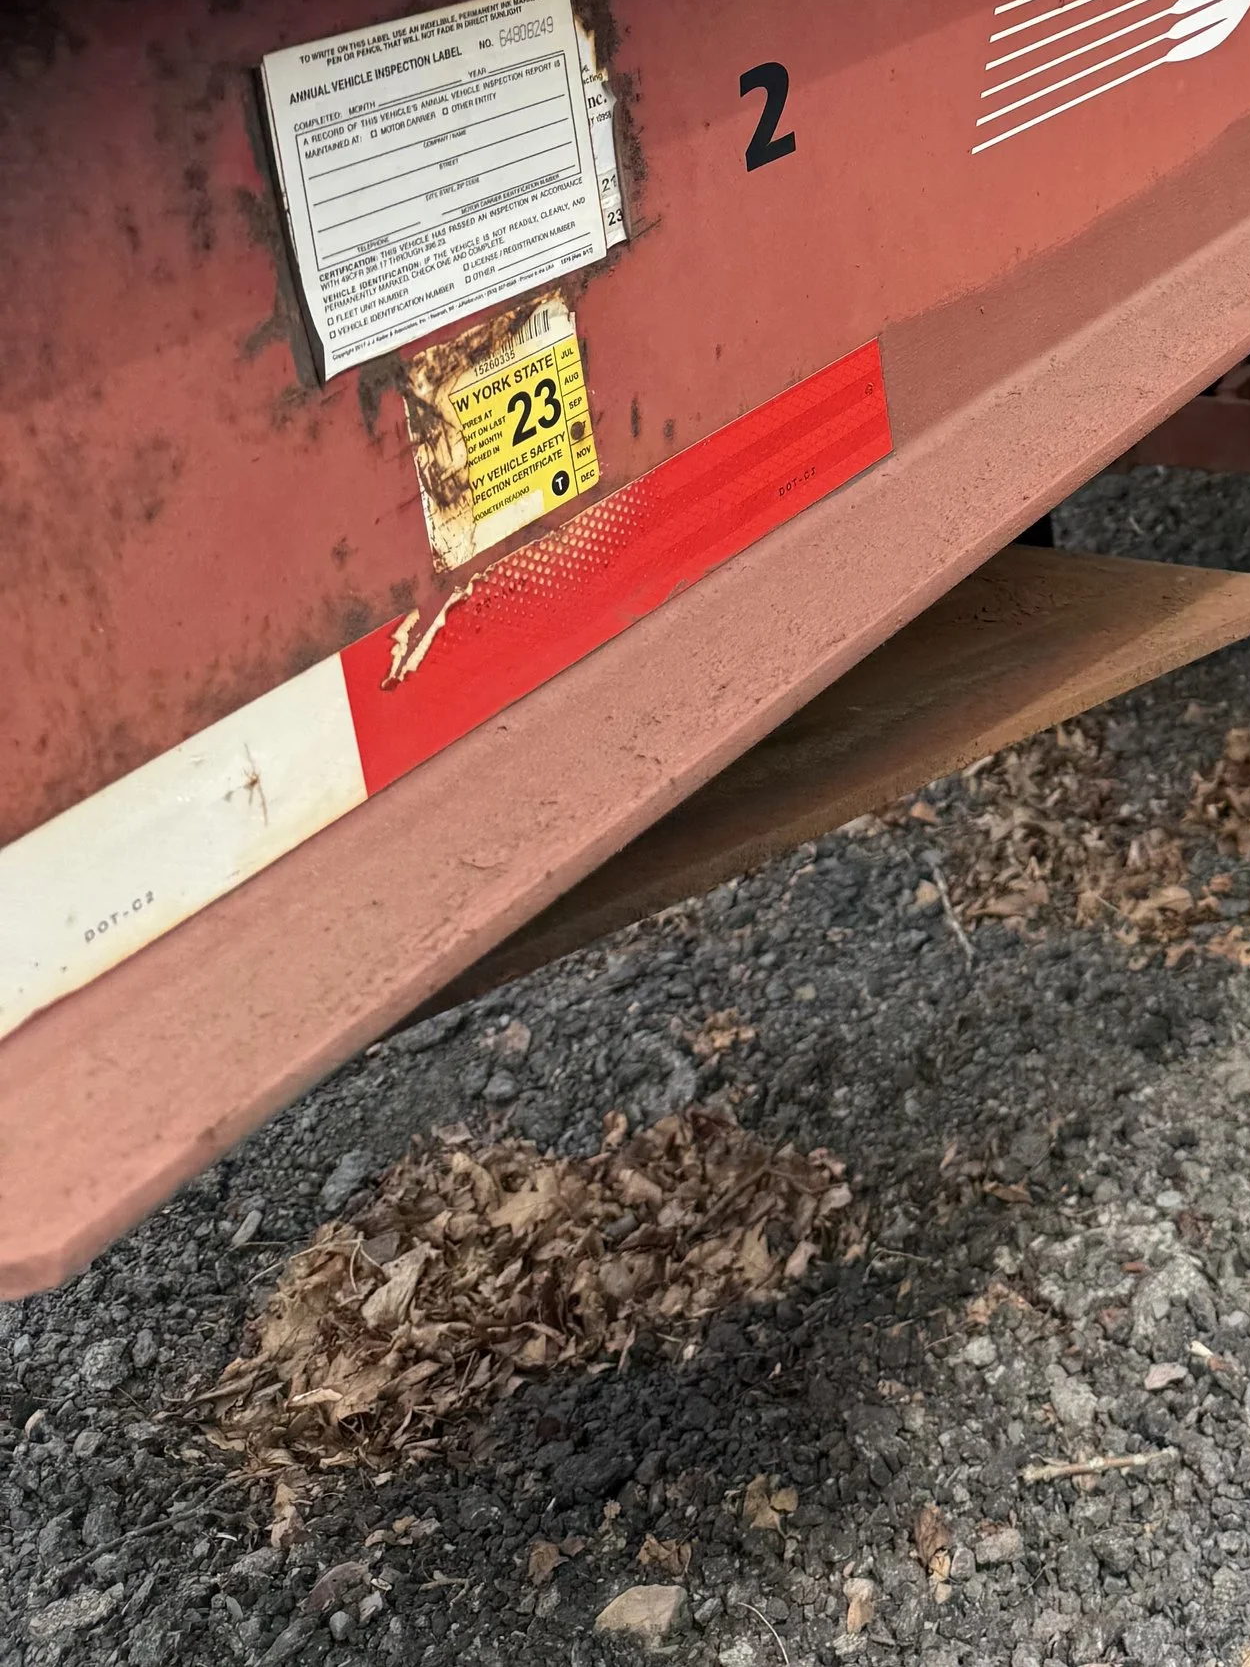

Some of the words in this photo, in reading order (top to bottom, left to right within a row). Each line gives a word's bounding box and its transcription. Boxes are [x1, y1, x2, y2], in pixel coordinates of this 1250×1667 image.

[299, 54, 310, 64] TO
[311, 47, 335, 61] WRITE
[337, 44, 348, 54] ON
[349, 39, 366, 50] THIS
[367, 33, 390, 46] LABEL
[392, 28, 407, 38] USE
[409, 25, 419, 34] AN
[458, 3, 499, 20] PERMANENT
[500, 0, 512, 9] INK
[326, 56, 342, 66] PEN
[343, 51, 355, 61] OR
[383, 38, 401, 50] THAT
[402, 34, 420, 45] WILL
[421, 29, 434, 40] NOT
[436, 24, 454, 35] FADE
[456, 22, 463, 30] IN
[464, 14, 488, 28] DIRECT
[489, 5, 522, 21] SUNLIGHT
[478, 38, 494, 50] NO.
[289, 84, 331, 105] ANNUAL
[331, 70, 373, 92] VEHICLE
[374, 54, 431, 80] INSPECTION
[432, 46, 462, 63] LABEL
[468, 67, 487, 78] YEAR
[303, 138, 309, 146] A
[311, 126, 345, 143] RECORD
[347, 121, 357, 132] OF
[360, 116, 378, 127] THIS
[420, 94, 449, 109] ANNUAL
[450, 84, 480, 100] VEHICLE
[482, 70, 523, 90] INSPECTION
[525, 62, 551, 76] REPORT
[554, 59, 560, 67] IS
[348, 101, 376, 116] MONTH
[451, 99, 474, 113] OTHER
[474, 92, 496, 106] ENTITY
[380, 121, 405, 135] MOTOR
[406, 111, 436, 127] CARRIER
[740, 62, 796, 172] 2
[305, 138, 350, 159] MAINTAINED
[380, 246, 397, 258] THIS
[399, 233, 429, 251] VEHICLE
[431, 227, 446, 239] HAS
[448, 217, 476, 233] PASSED
[478, 213, 487, 222] AN
[489, 197, 529, 217] INSPECTION
[531, 193, 538, 202] IN
[540, 176, 583, 198] ACCORDANCE
[322, 285, 356, 304] VEHICLE
[424, 255, 430, 265] IF
[433, 249, 447, 261] THE
[450, 236, 479, 254] VEHICLE
[482, 233, 490, 241] IS
[492, 226, 506, 238] NOT
[572, 196, 585, 207] AND
[470, 251, 498, 268] LICENSE
[503, 231, 549, 255] REGISTRATION
[549, 221, 576, 237] NUMBER
[320, 278, 340, 292] WITH
[388, 246, 424, 265] THROUGH
[324, 287, 377, 313] PERMANENTLY
[411, 263, 436, 279] CHECK
[436, 257, 451, 269] ONE
[452, 251, 467, 262] AND
[472, 265, 495, 281] OTHER
[335, 307, 358, 323] FLEET
[359, 300, 376, 313] UNIT
[378, 287, 409, 306] NUMBER
[337, 317, 368, 336] VEHICLE
[370, 295, 424, 323] IDENTIFICATION
[425, 282, 455, 300] NUMBER
[474, 350, 516, 377] 15260335
[560, 348, 575, 360] JUL
[472, 375, 511, 404] YORK
[514, 354, 554, 384] STATE
[564, 372, 579, 386] AUG
[484, 409, 493, 421] AT
[507, 378, 562, 447] 23
[568, 396, 583, 410] SEP
[478, 425, 488, 436] ON
[489, 415, 506, 430] LAST
[468, 444, 478, 454] OF
[479, 431, 503, 449] MONTH
[493, 445, 500, 455] IN
[576, 445, 591, 459] NOV
[487, 452, 528, 482] VEHICLE
[530, 431, 566, 458] SAFETY
[512, 449, 563, 483] CERTIFICATE
[555, 477, 564, 491] T
[580, 470, 595, 483] DEC
[84, 890, 155, 943] DOT-C2
